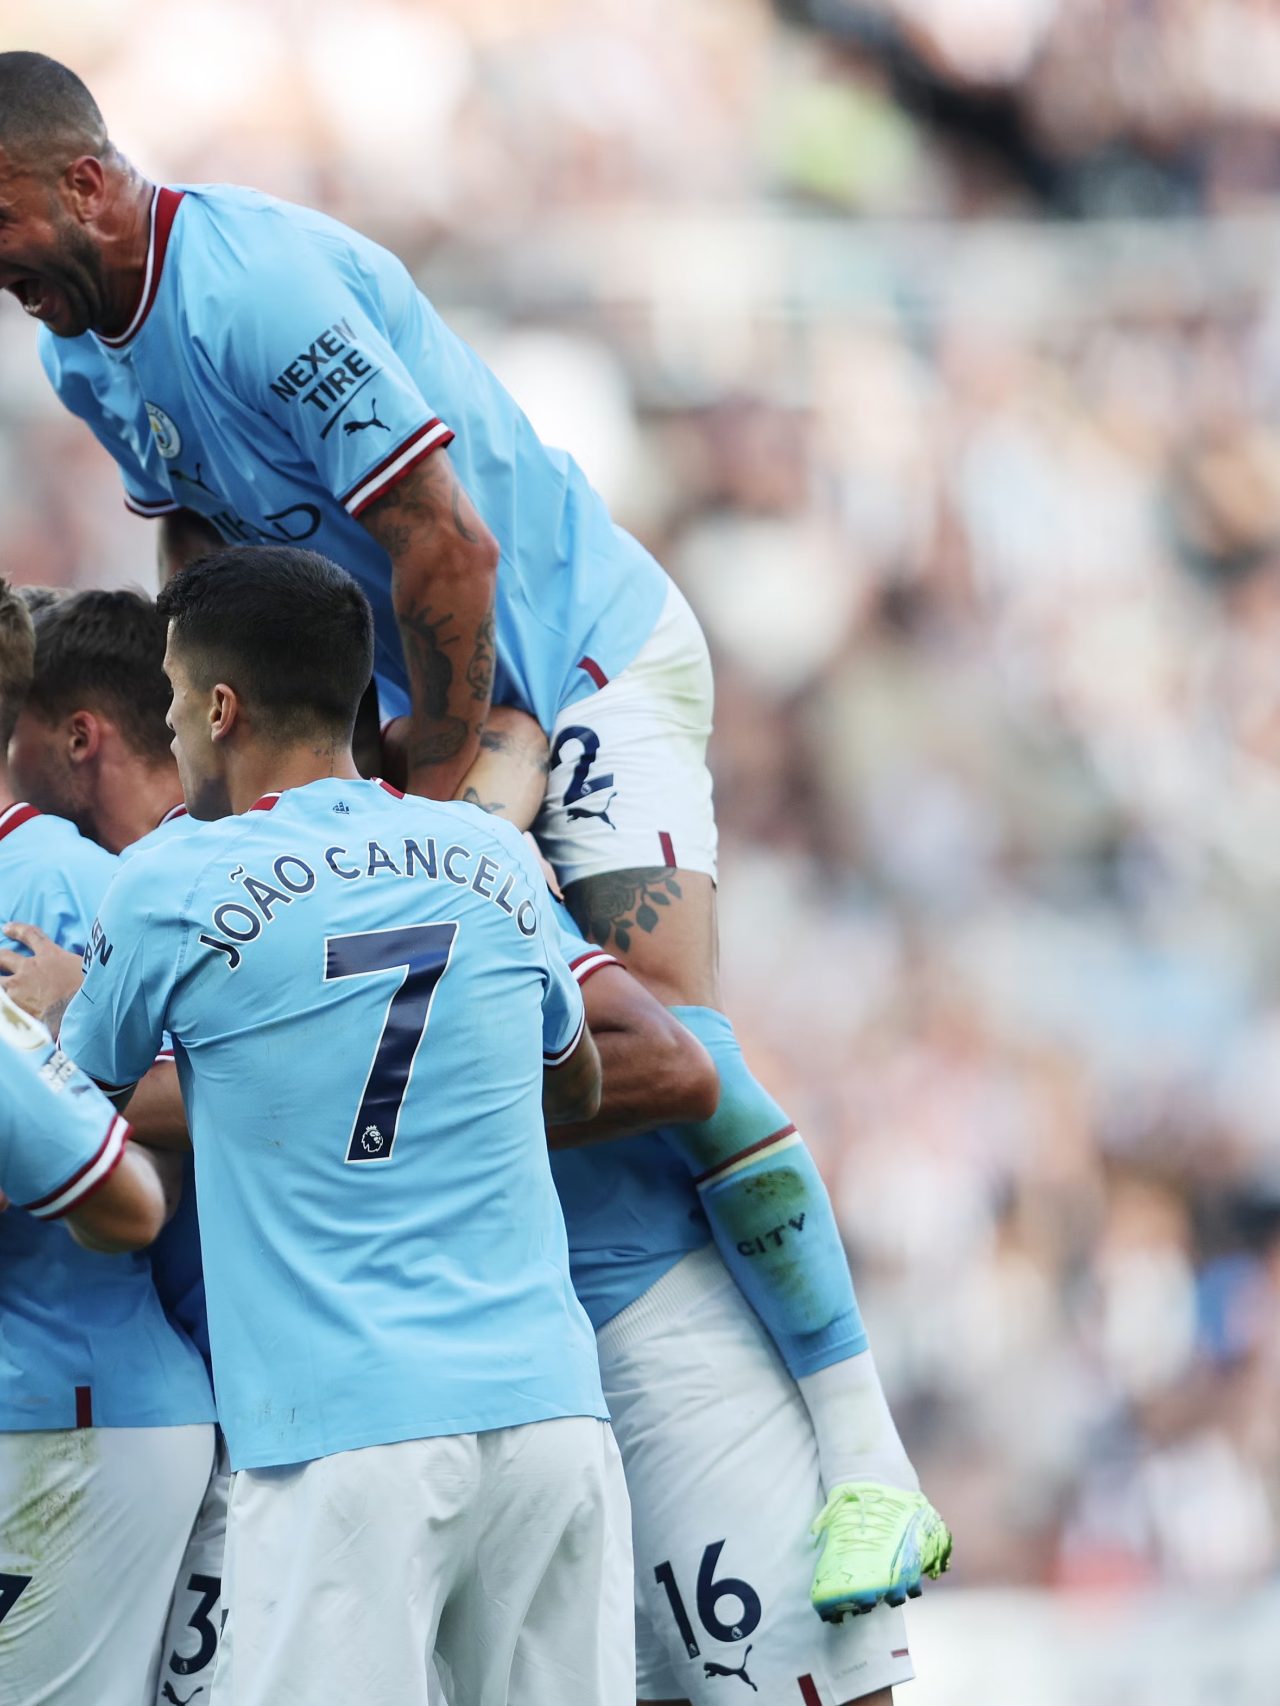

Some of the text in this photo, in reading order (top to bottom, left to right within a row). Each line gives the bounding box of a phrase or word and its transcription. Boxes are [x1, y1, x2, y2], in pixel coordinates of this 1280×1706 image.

[269, 315, 358, 403] NEXEN
[301, 349, 372, 412] TIRE
[551, 725, 614, 807] 2
[198, 837, 539, 969] JOÃO CANCELO
[323, 920, 460, 1163] 7
[736, 1212, 806, 1257] CITY
[169, 1572, 222, 1675] 3
[654, 1538, 762, 1659] 16
